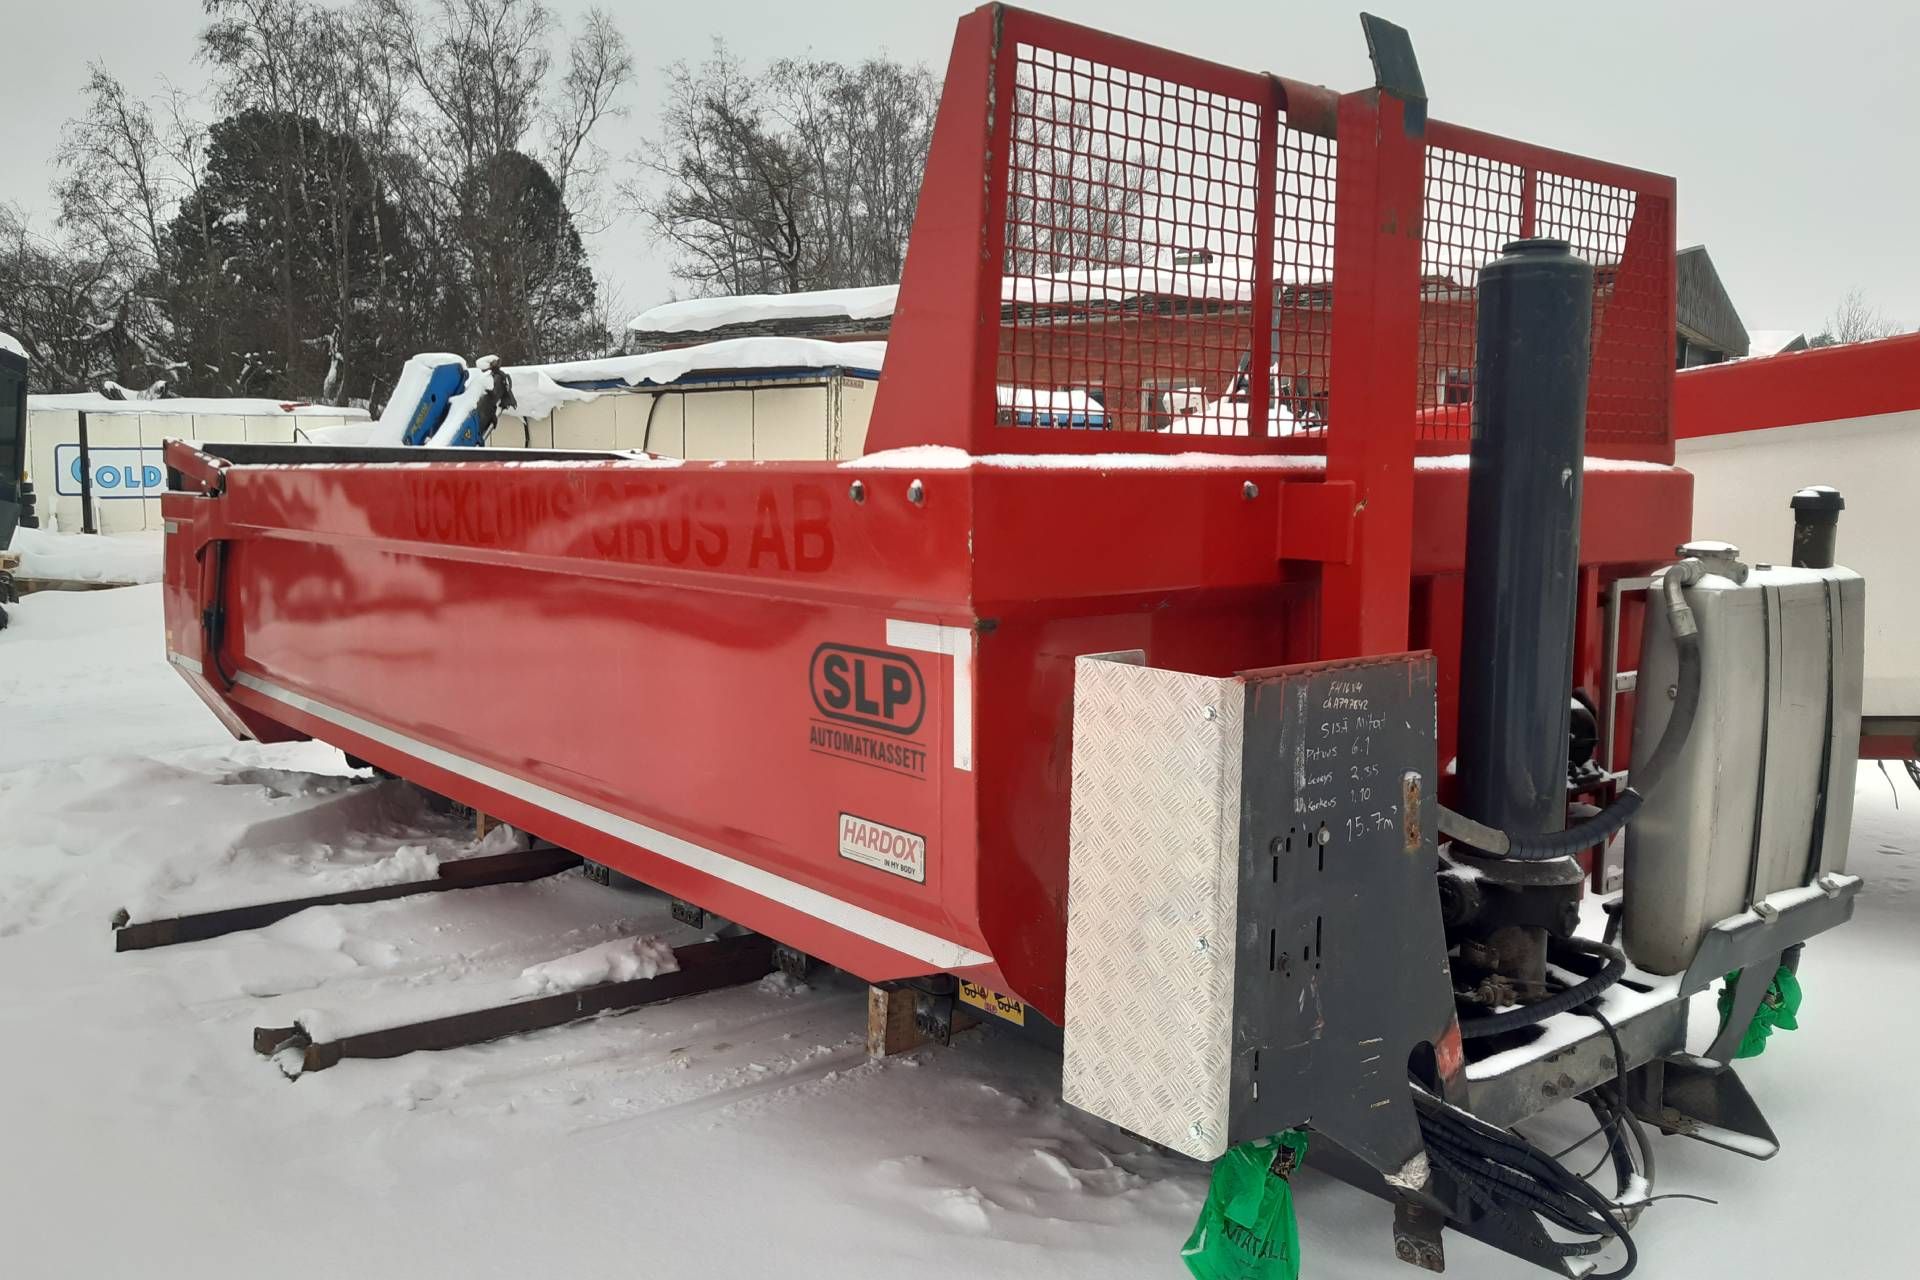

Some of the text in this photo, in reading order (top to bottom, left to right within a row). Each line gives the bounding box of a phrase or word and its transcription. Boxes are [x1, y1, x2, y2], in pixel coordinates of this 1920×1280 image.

[412, 478, 834, 574] UCKLUMS GRUS AB
[823, 654, 913, 719] SLP
[809, 726, 927, 773] AUTOMATKASSETT
[1351, 736, 1370, 755] 6.1
[843, 819, 918, 863] HARDOX
[884, 859, 916, 875] IN MY BODY
